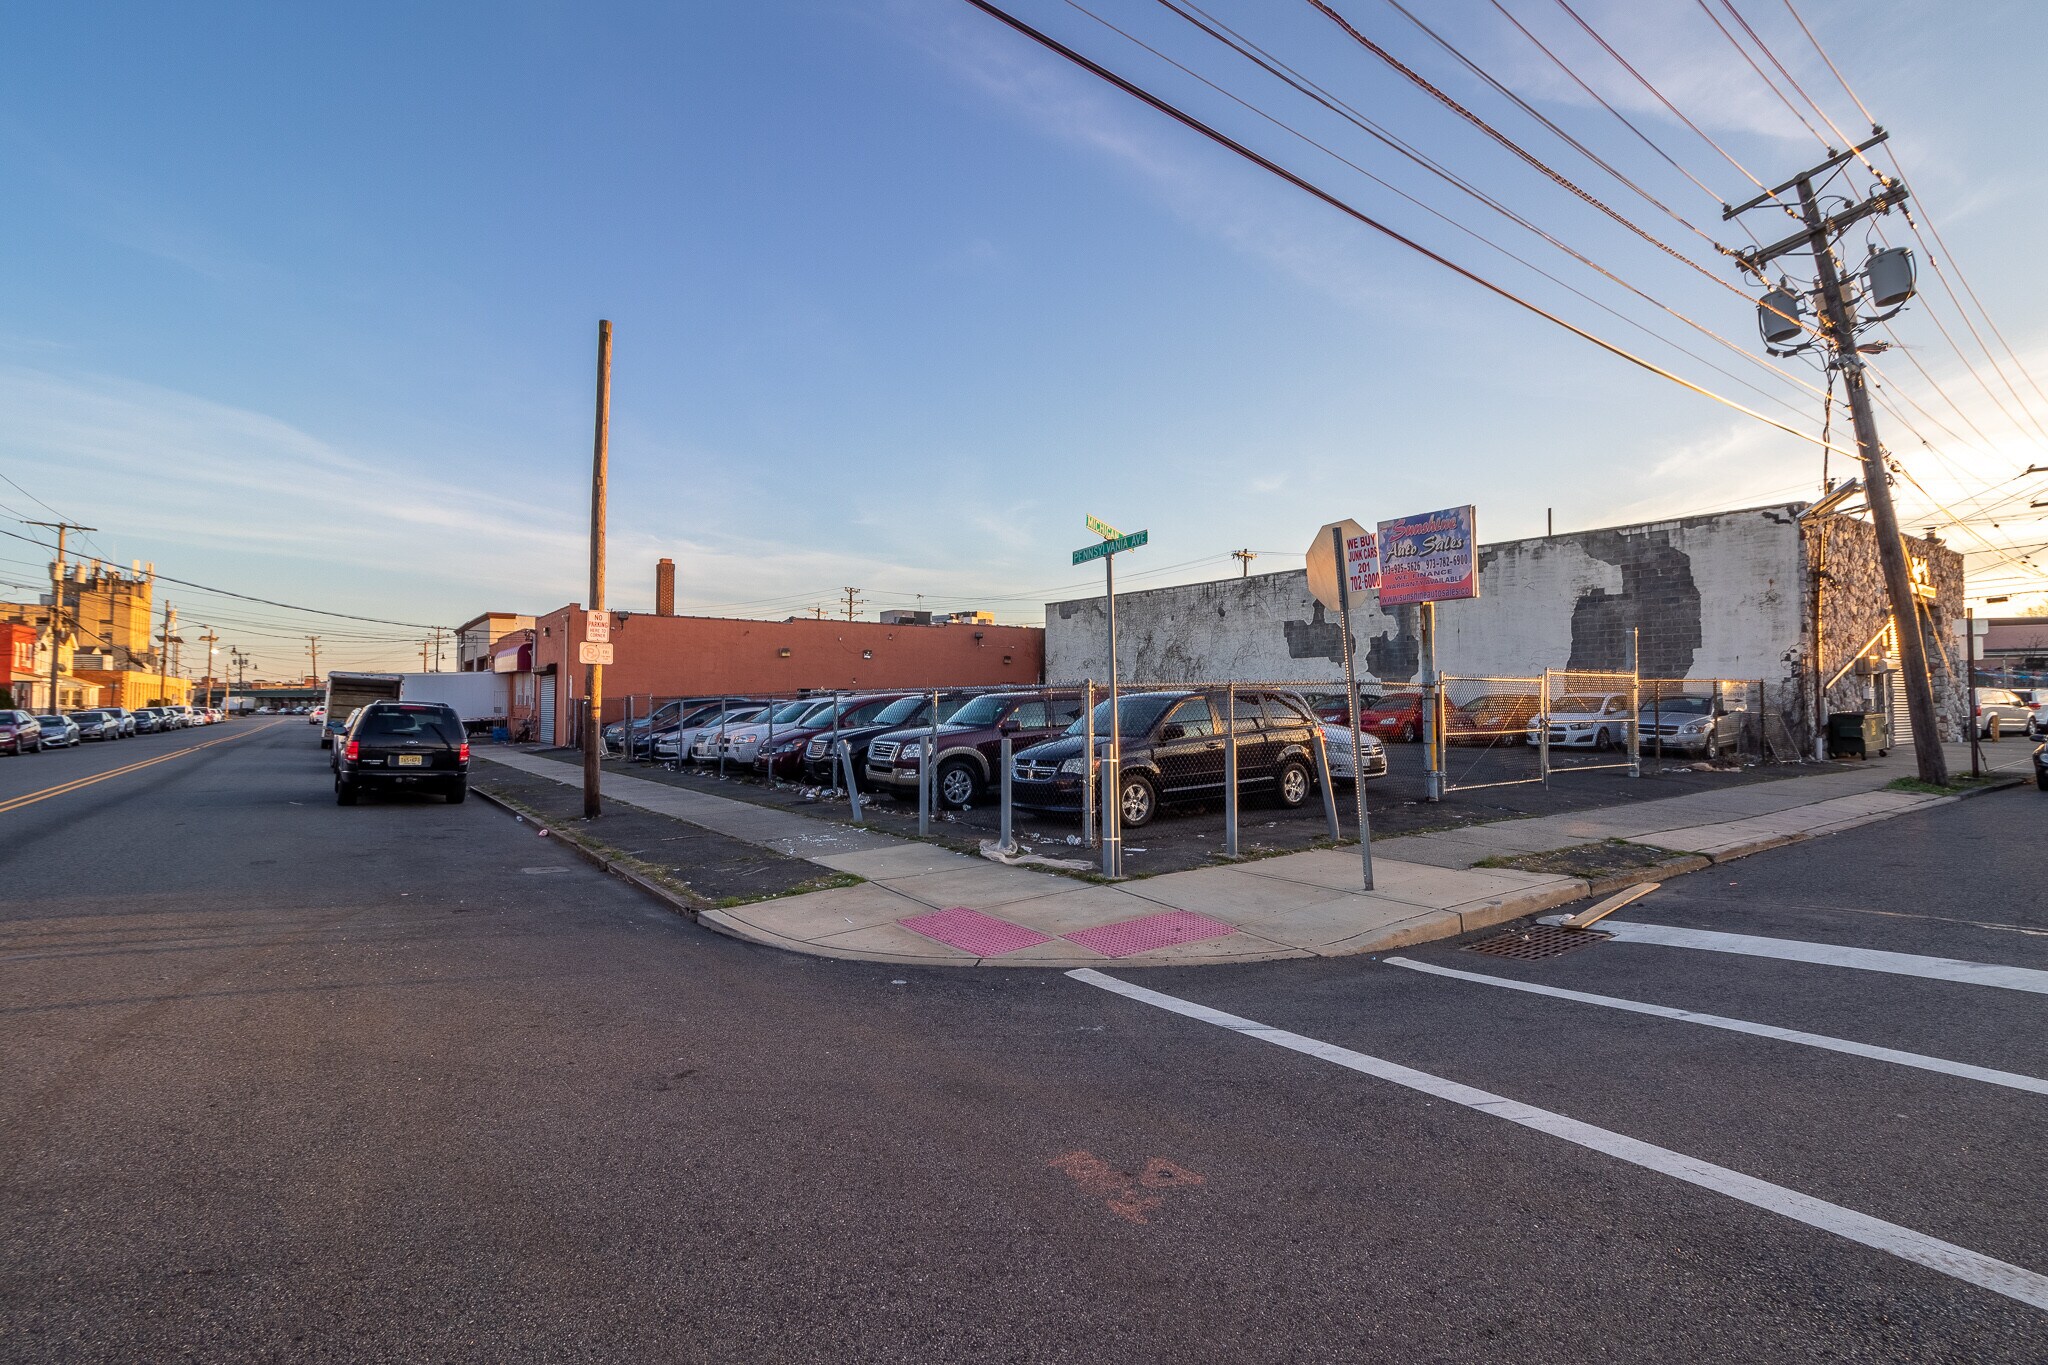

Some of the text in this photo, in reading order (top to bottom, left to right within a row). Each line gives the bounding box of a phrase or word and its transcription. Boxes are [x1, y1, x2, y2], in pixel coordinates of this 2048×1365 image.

[1389, 514, 1457, 542] Sunshine
[1074, 533, 1146, 562] PENNSYLVANIA AVE
[1347, 533, 1376, 550] WE BUY
[1385, 535, 1464, 563] Auto Sales
[1349, 547, 1377, 562] JUNK CARS
[1358, 562, 1370, 573] 201
[1412, 569, 1452, 578] FINANCE
[1350, 573, 1380, 591] 702-6000
[1386, 575, 1463, 590] WARRANTY AVAILABLE
